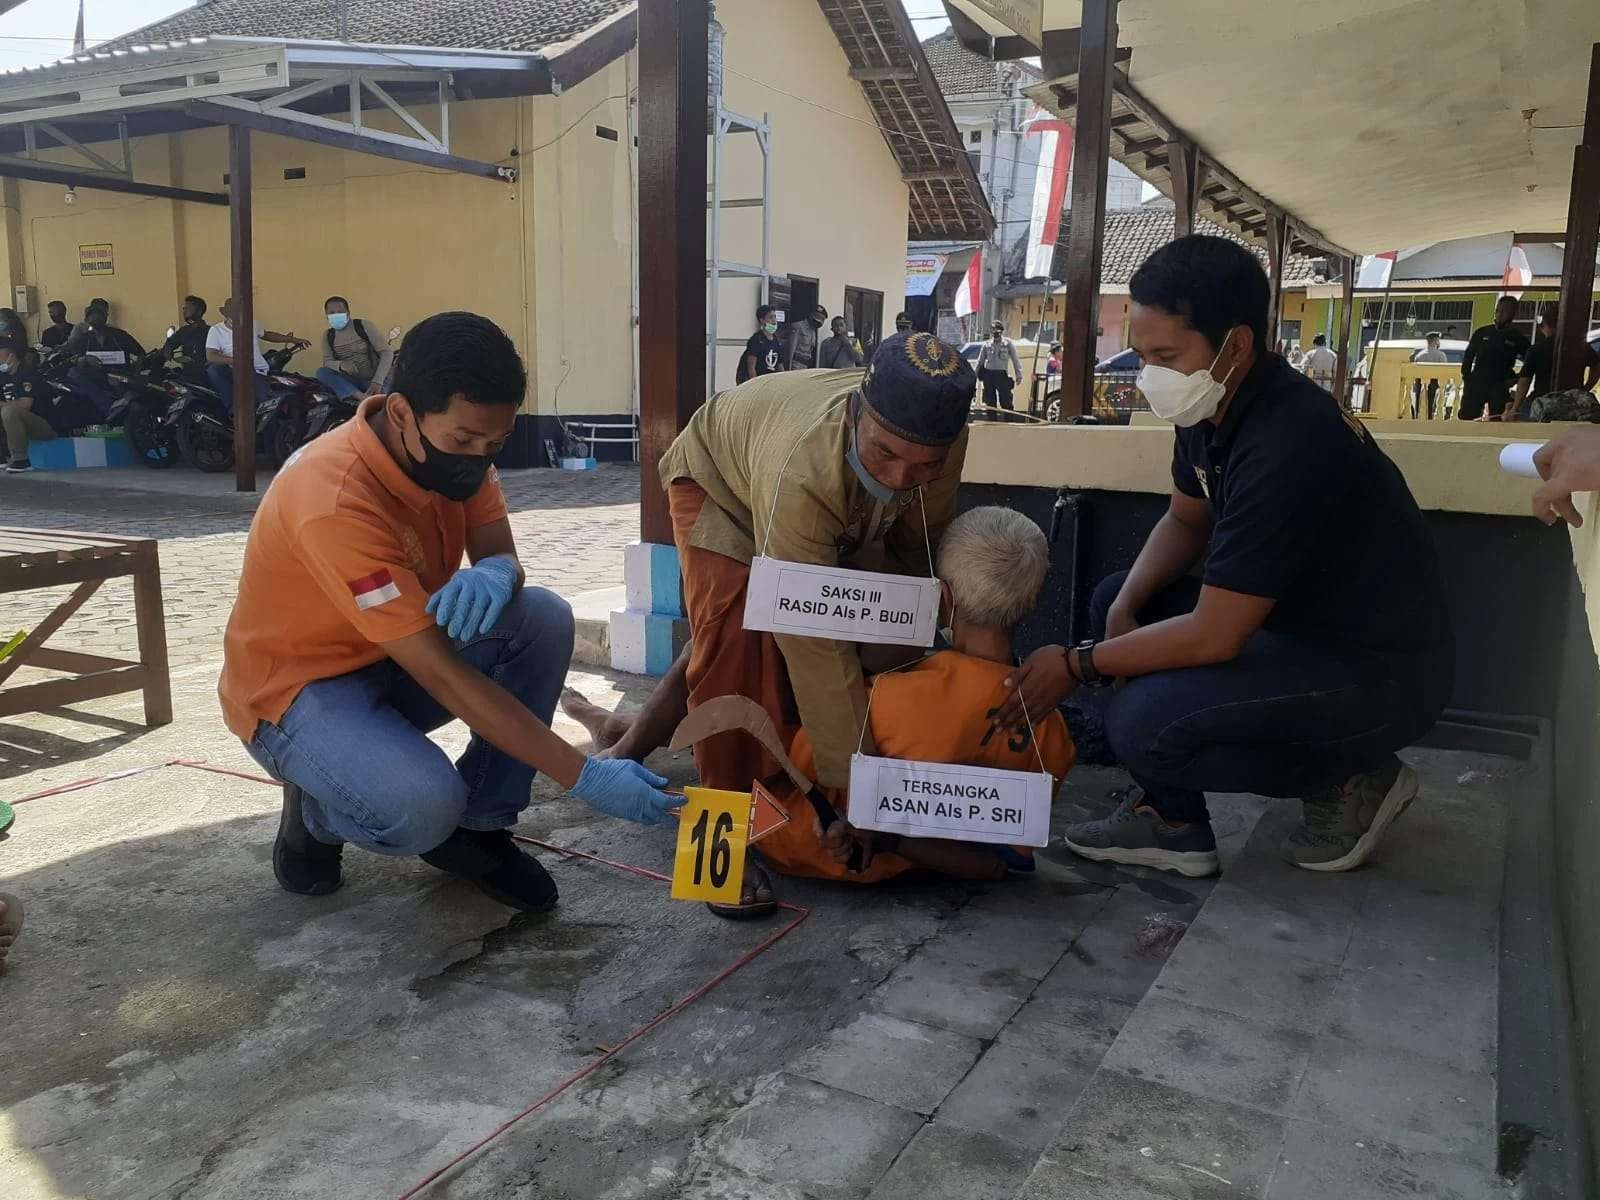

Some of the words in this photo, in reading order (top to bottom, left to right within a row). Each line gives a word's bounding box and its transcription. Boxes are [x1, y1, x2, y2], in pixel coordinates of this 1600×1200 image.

[821, 585, 866, 602] SAKSI
[869, 591, 882, 603] III
[779, 598, 828, 616] RASID
[832, 605, 856, 619] Als
[861, 608, 874, 621] P.
[879, 610, 914, 625] BUDI
[902, 779, 1000, 800] TERSANGKA
[878, 796, 929, 815] ASAN
[934, 802, 962, 819] Als
[968, 805, 985, 821] P.
[991, 807, 1022, 824] SRI
[691, 809, 734, 888] 16
